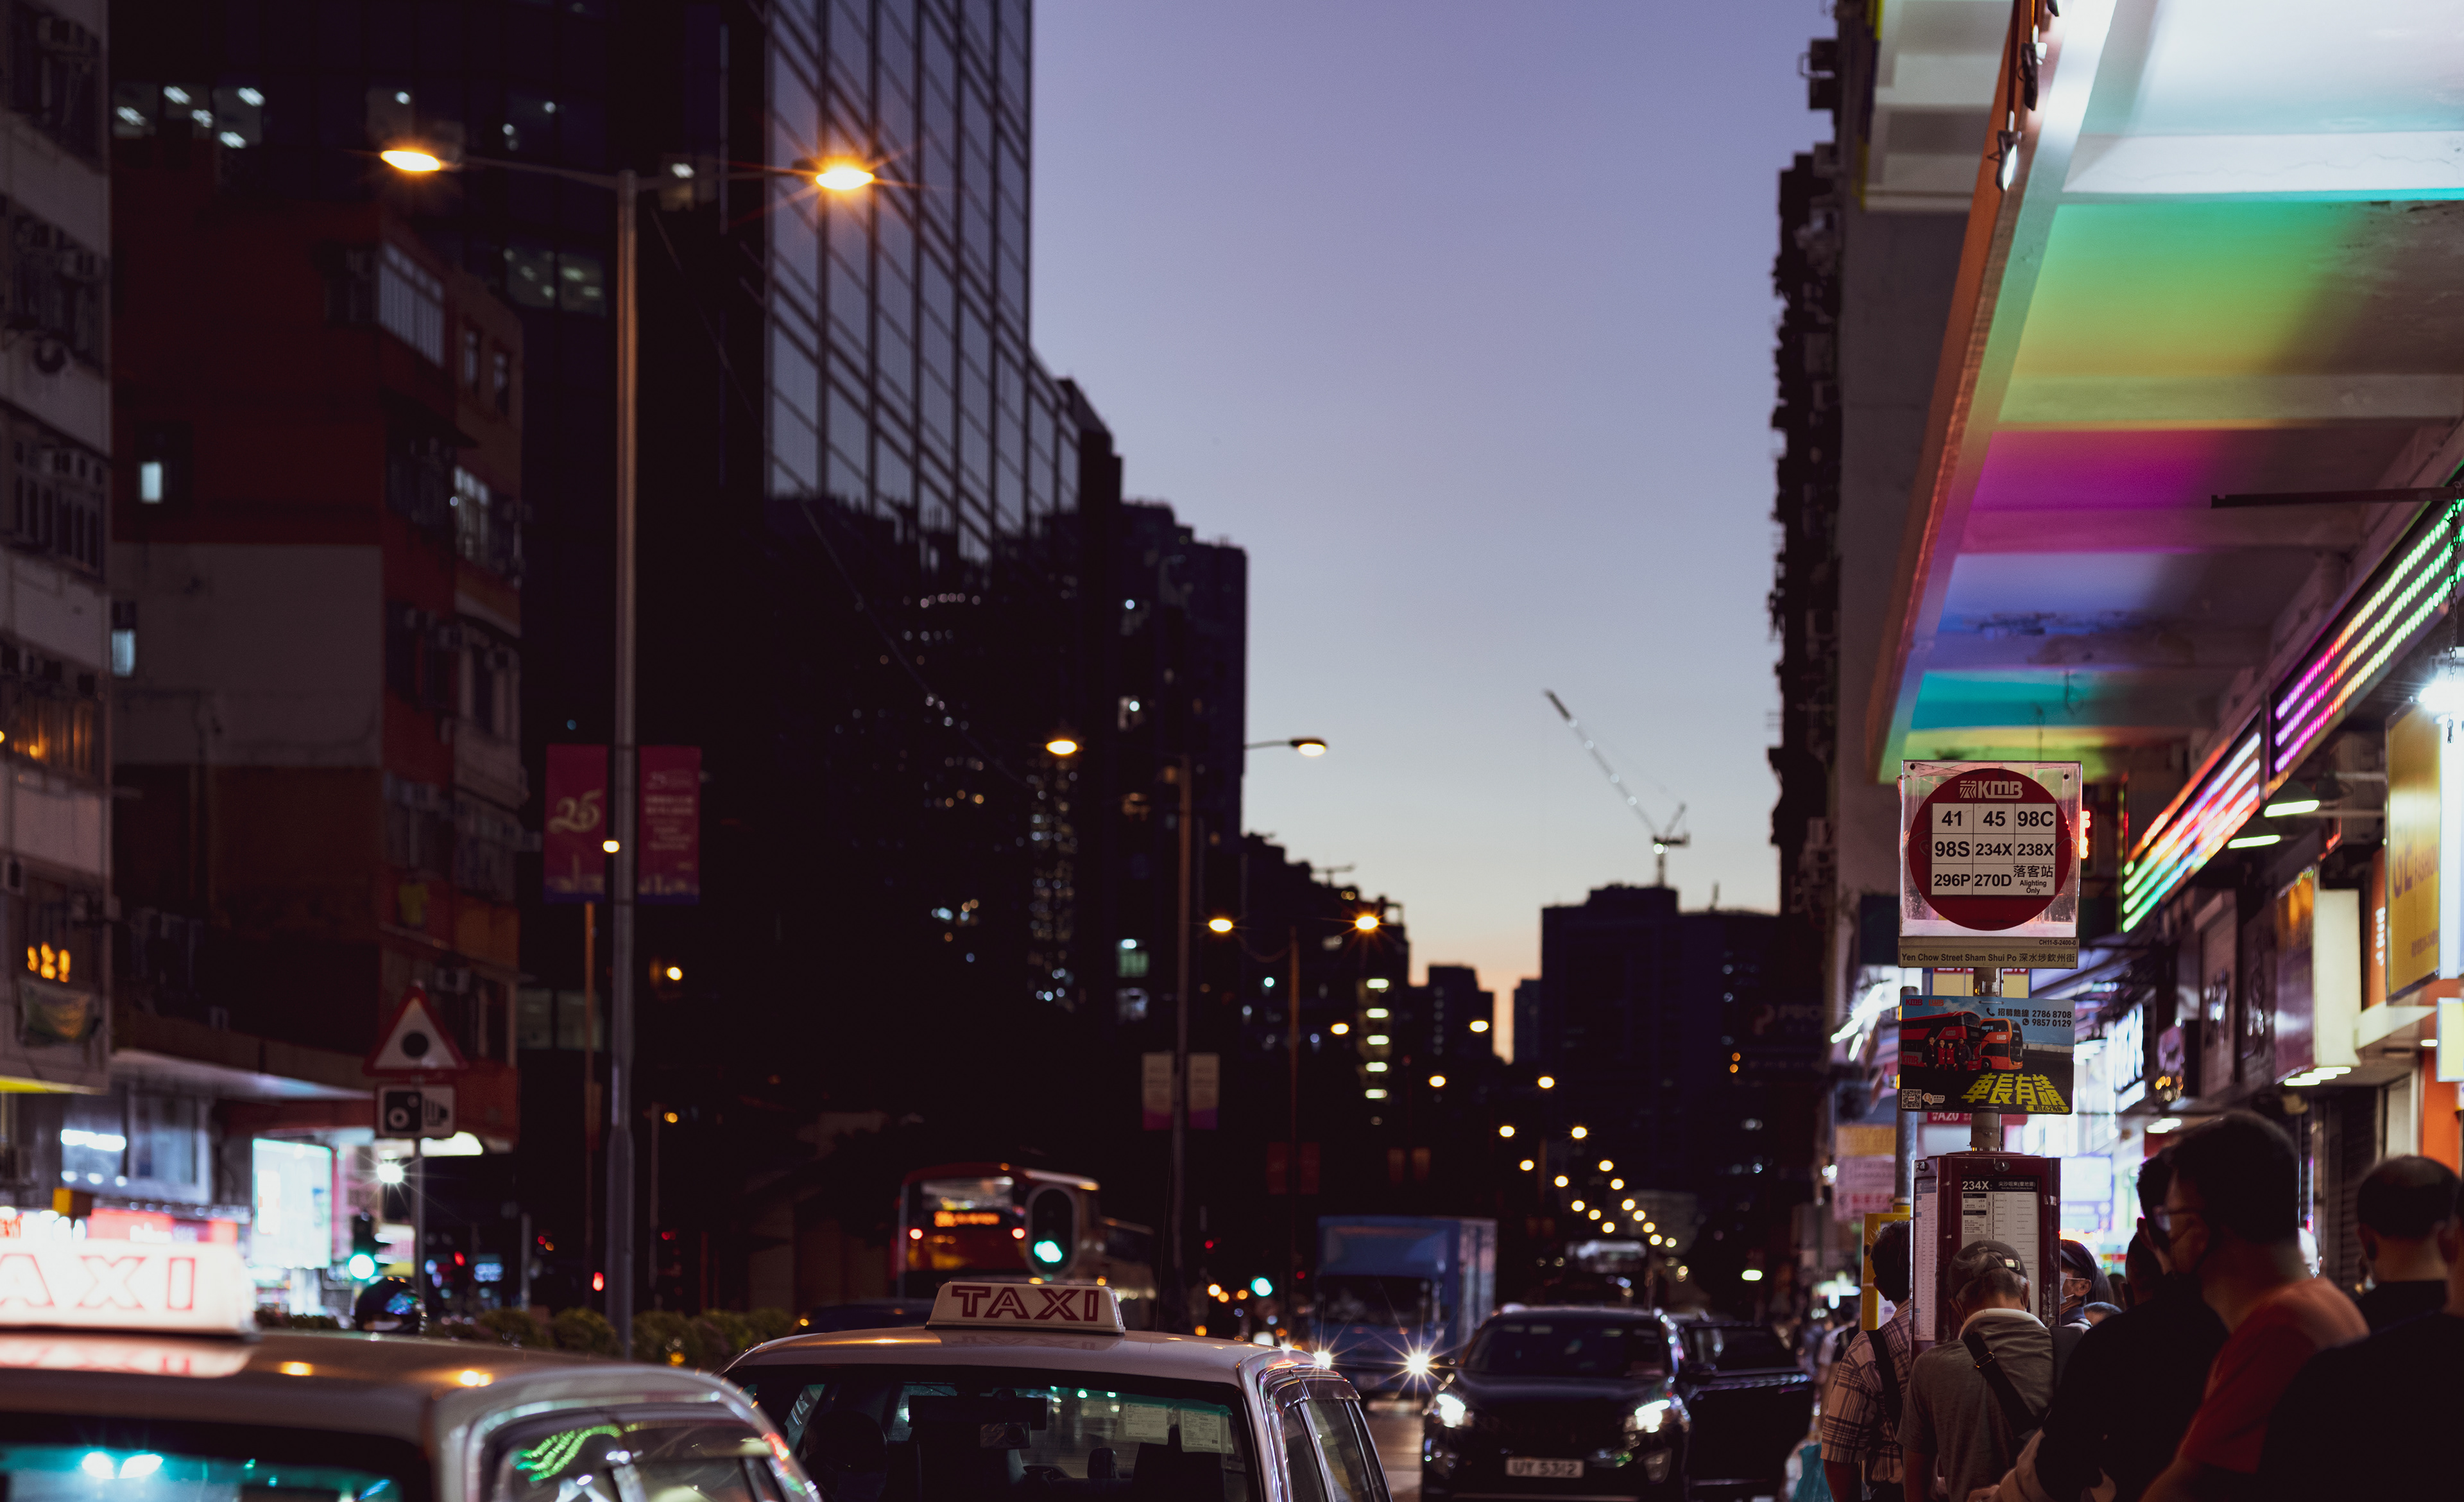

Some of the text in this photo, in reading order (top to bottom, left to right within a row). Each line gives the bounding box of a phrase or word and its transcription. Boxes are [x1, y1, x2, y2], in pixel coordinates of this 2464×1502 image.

[1978, 781, 2023, 799] KMB
[1942, 810, 1962, 827] 41
[1983, 811, 2006, 827] 45
[2017, 811, 2054, 827] 98C
[1935, 841, 1970, 858] 98S
[1975, 843, 2013, 856] 234X
[2017, 843, 2054, 856] 238X
[2013, 865, 2053, 878] 落客站
[1934, 874, 1971, 887] 296P
[1974, 874, 2012, 887] 270D
[1901, 953, 1919, 962] Yen
[1988, 954, 2006, 962] Shui
[2019, 953, 2075, 963] 深水埗欽州街
[2032, 1010, 2051, 1018] 2786
[1961, 1073, 2066, 1106] 車長有請
[1962, 1180, 1989, 1190] 234X
[951, 1285, 1099, 1322] TAXI
